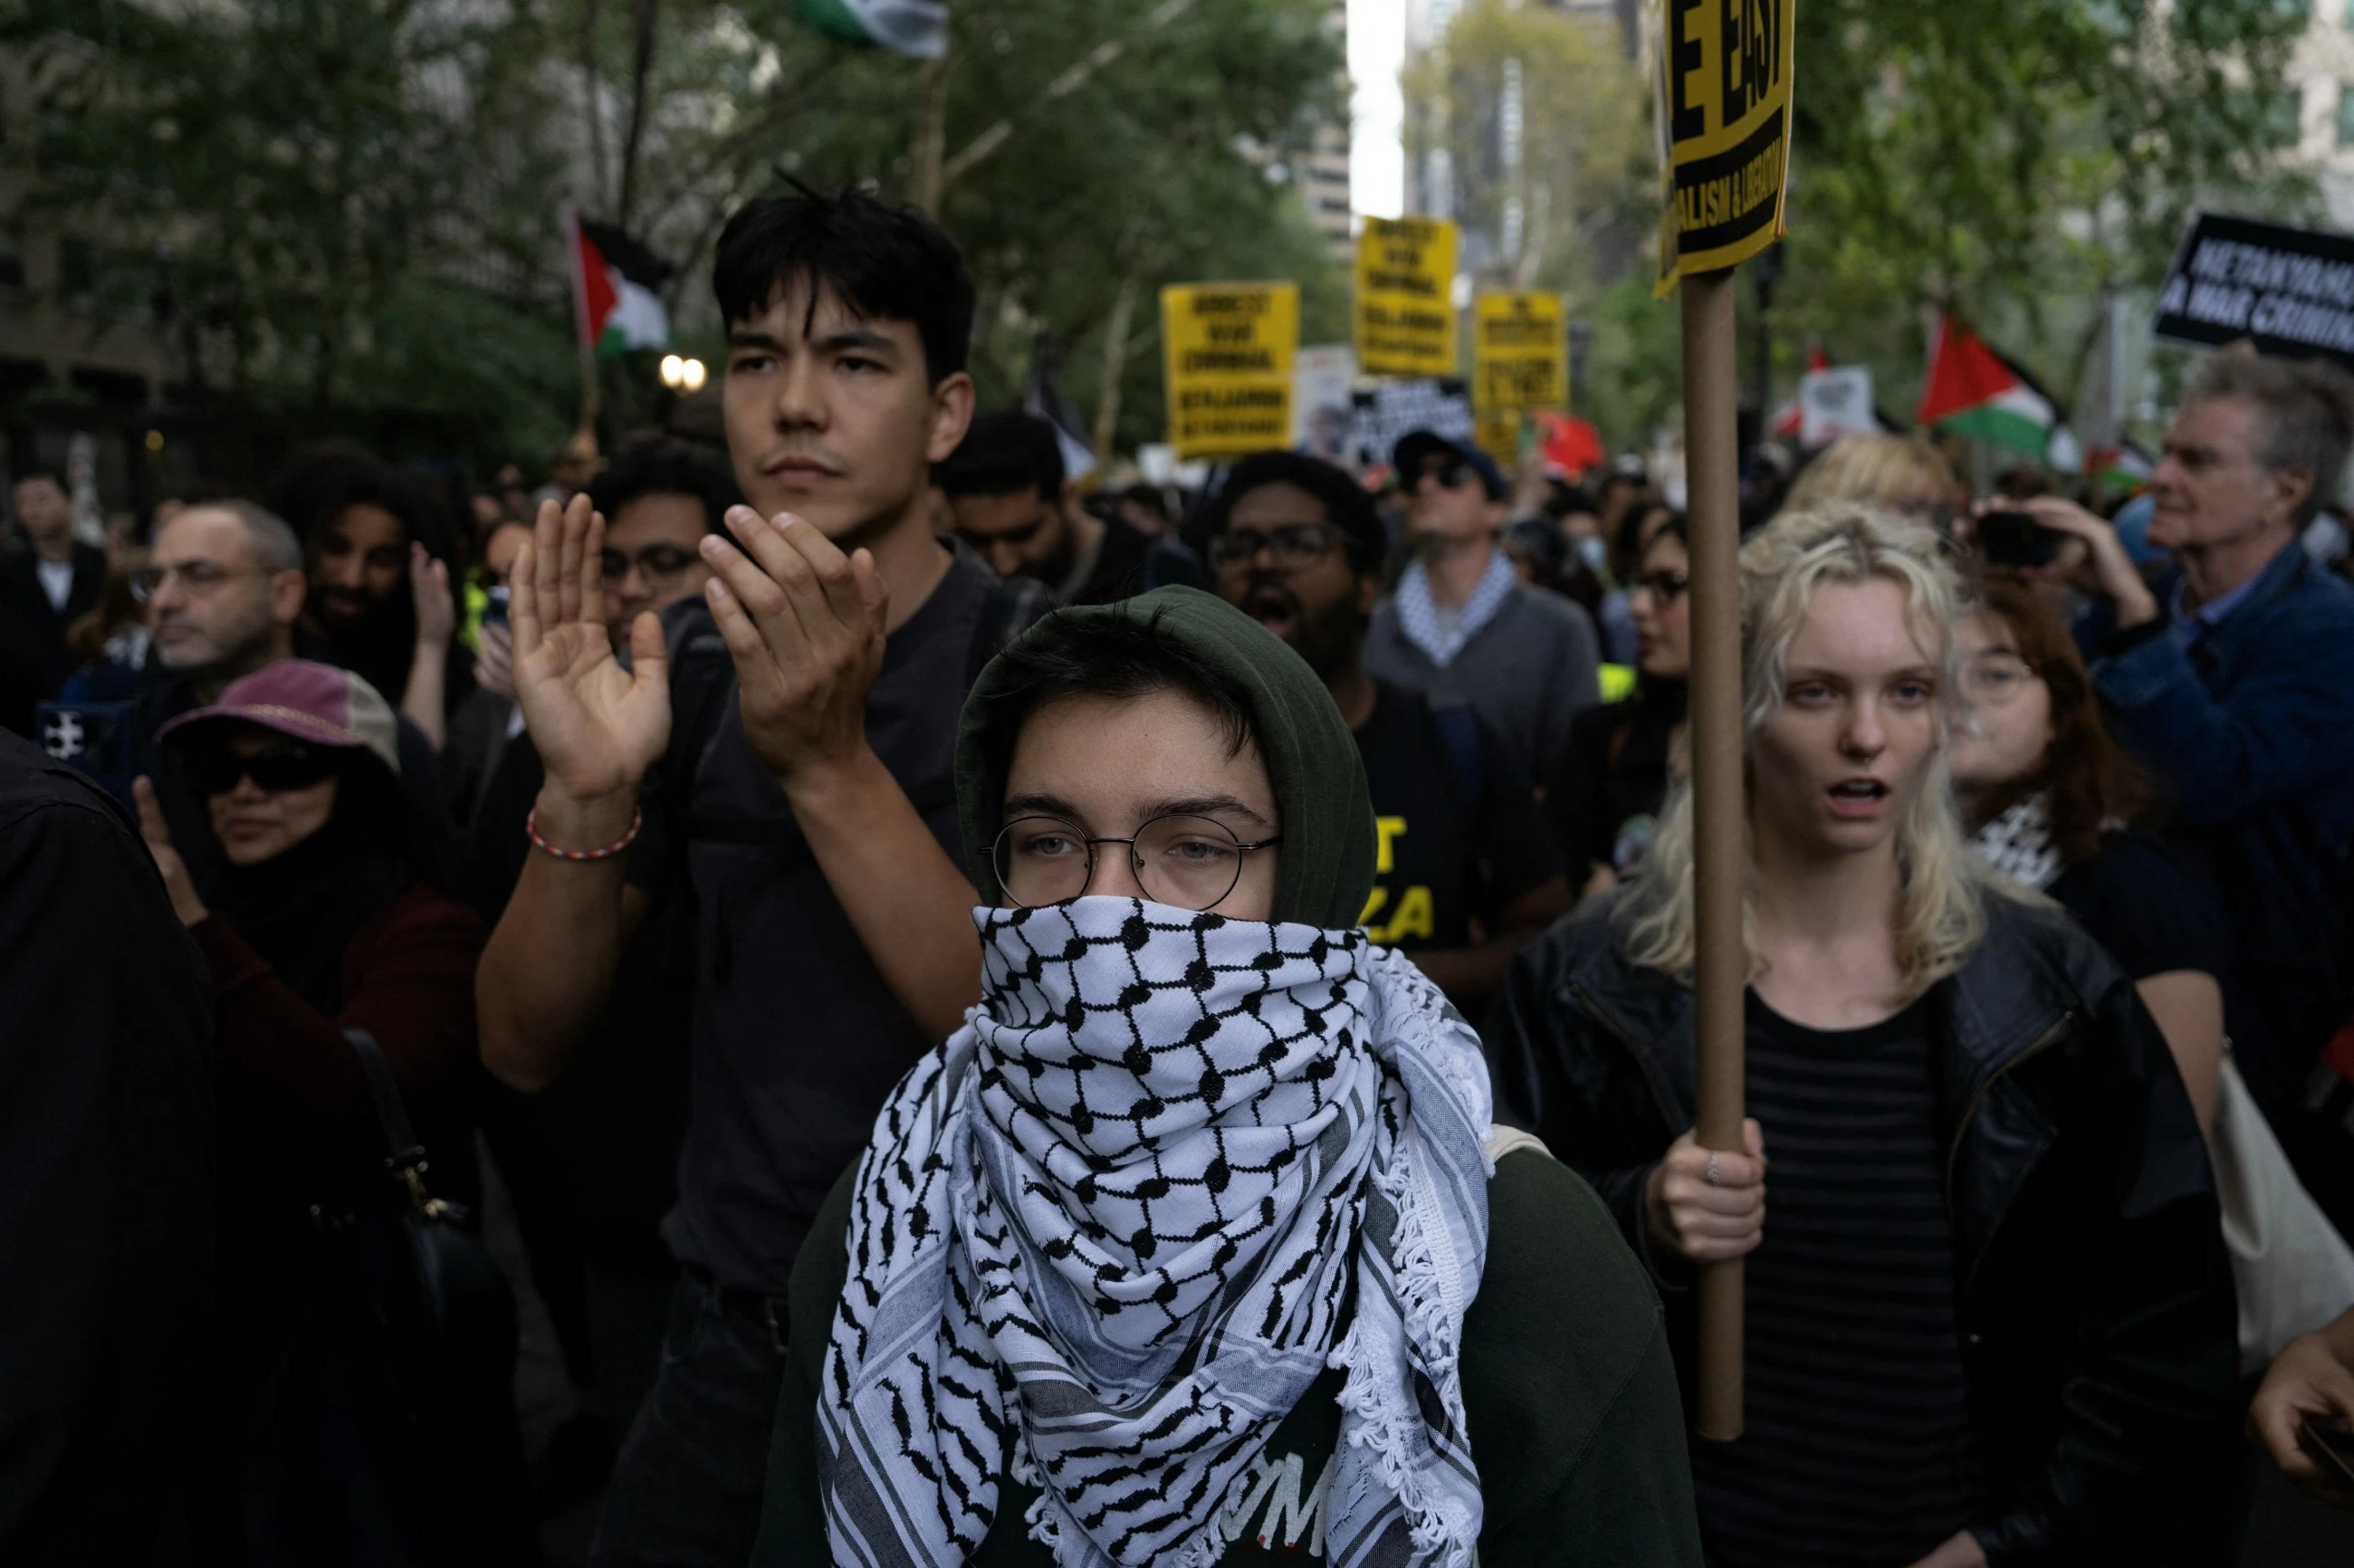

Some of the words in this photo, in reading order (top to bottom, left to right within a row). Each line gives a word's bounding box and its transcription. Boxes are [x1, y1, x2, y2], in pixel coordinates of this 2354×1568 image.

[1722, 0, 1781, 128] EAST
[1732, 171, 1741, 219] &
[2157, 272, 2187, 315] A
[2186, 282, 2254, 330] WAR
[2189, 235, 2354, 309] NETANYAH
